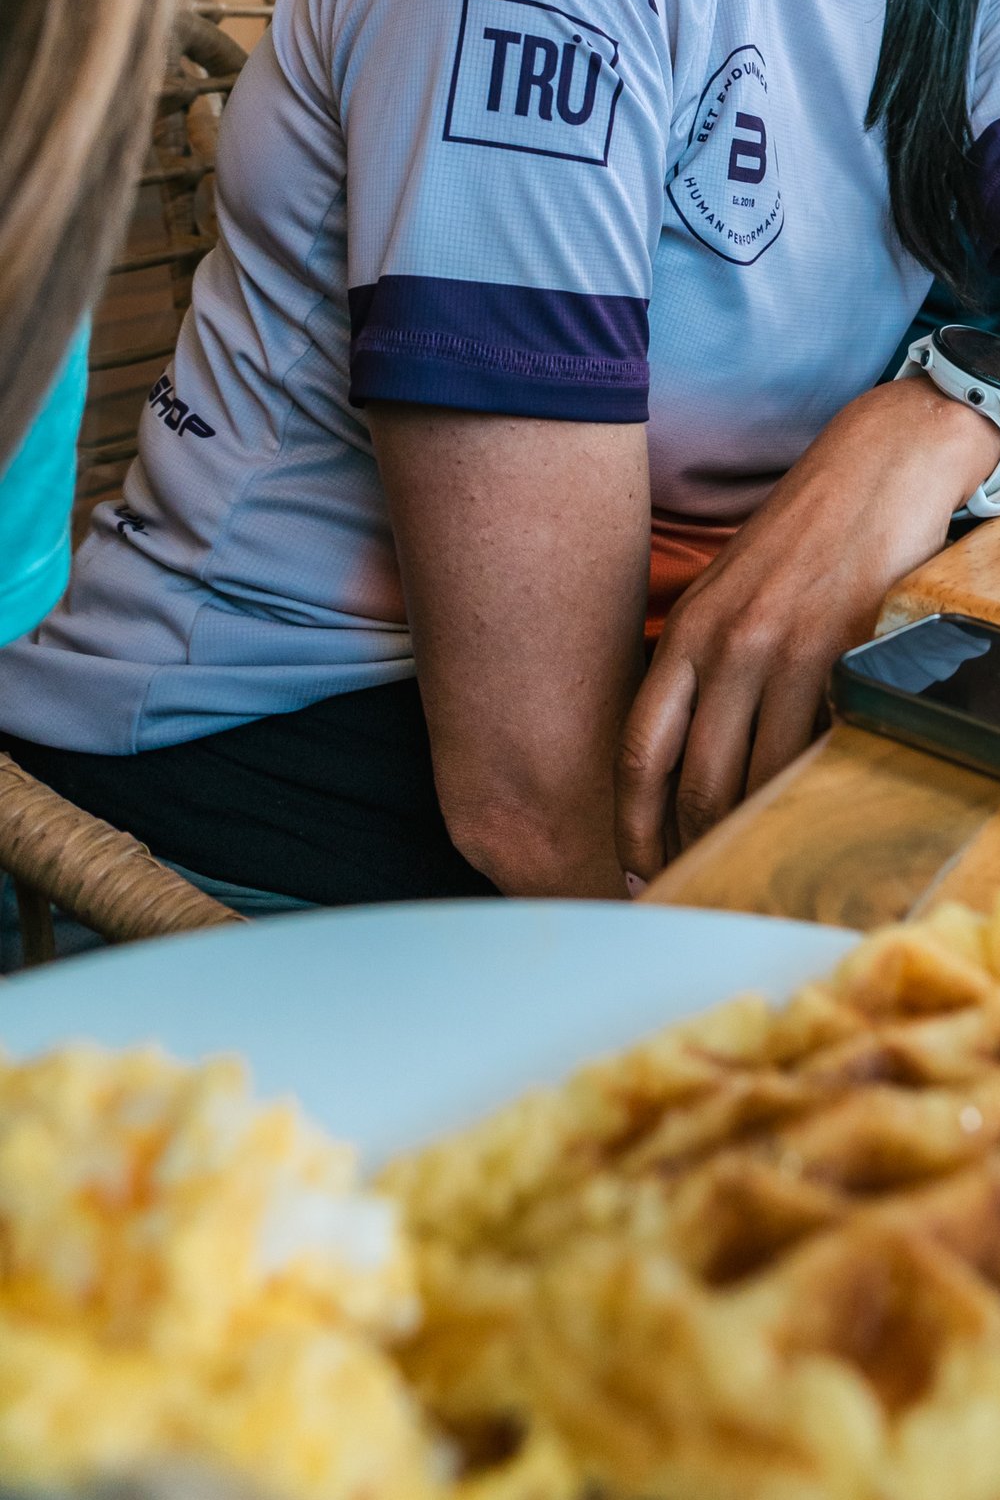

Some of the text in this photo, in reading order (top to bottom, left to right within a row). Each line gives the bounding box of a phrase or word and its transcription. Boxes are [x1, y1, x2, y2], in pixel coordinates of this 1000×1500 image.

[697, 108, 719, 143] BET
[727, 111, 767, 185] B
[684, 176, 725, 233] HUMAN
[149, 374, 217, 439] SHOP
